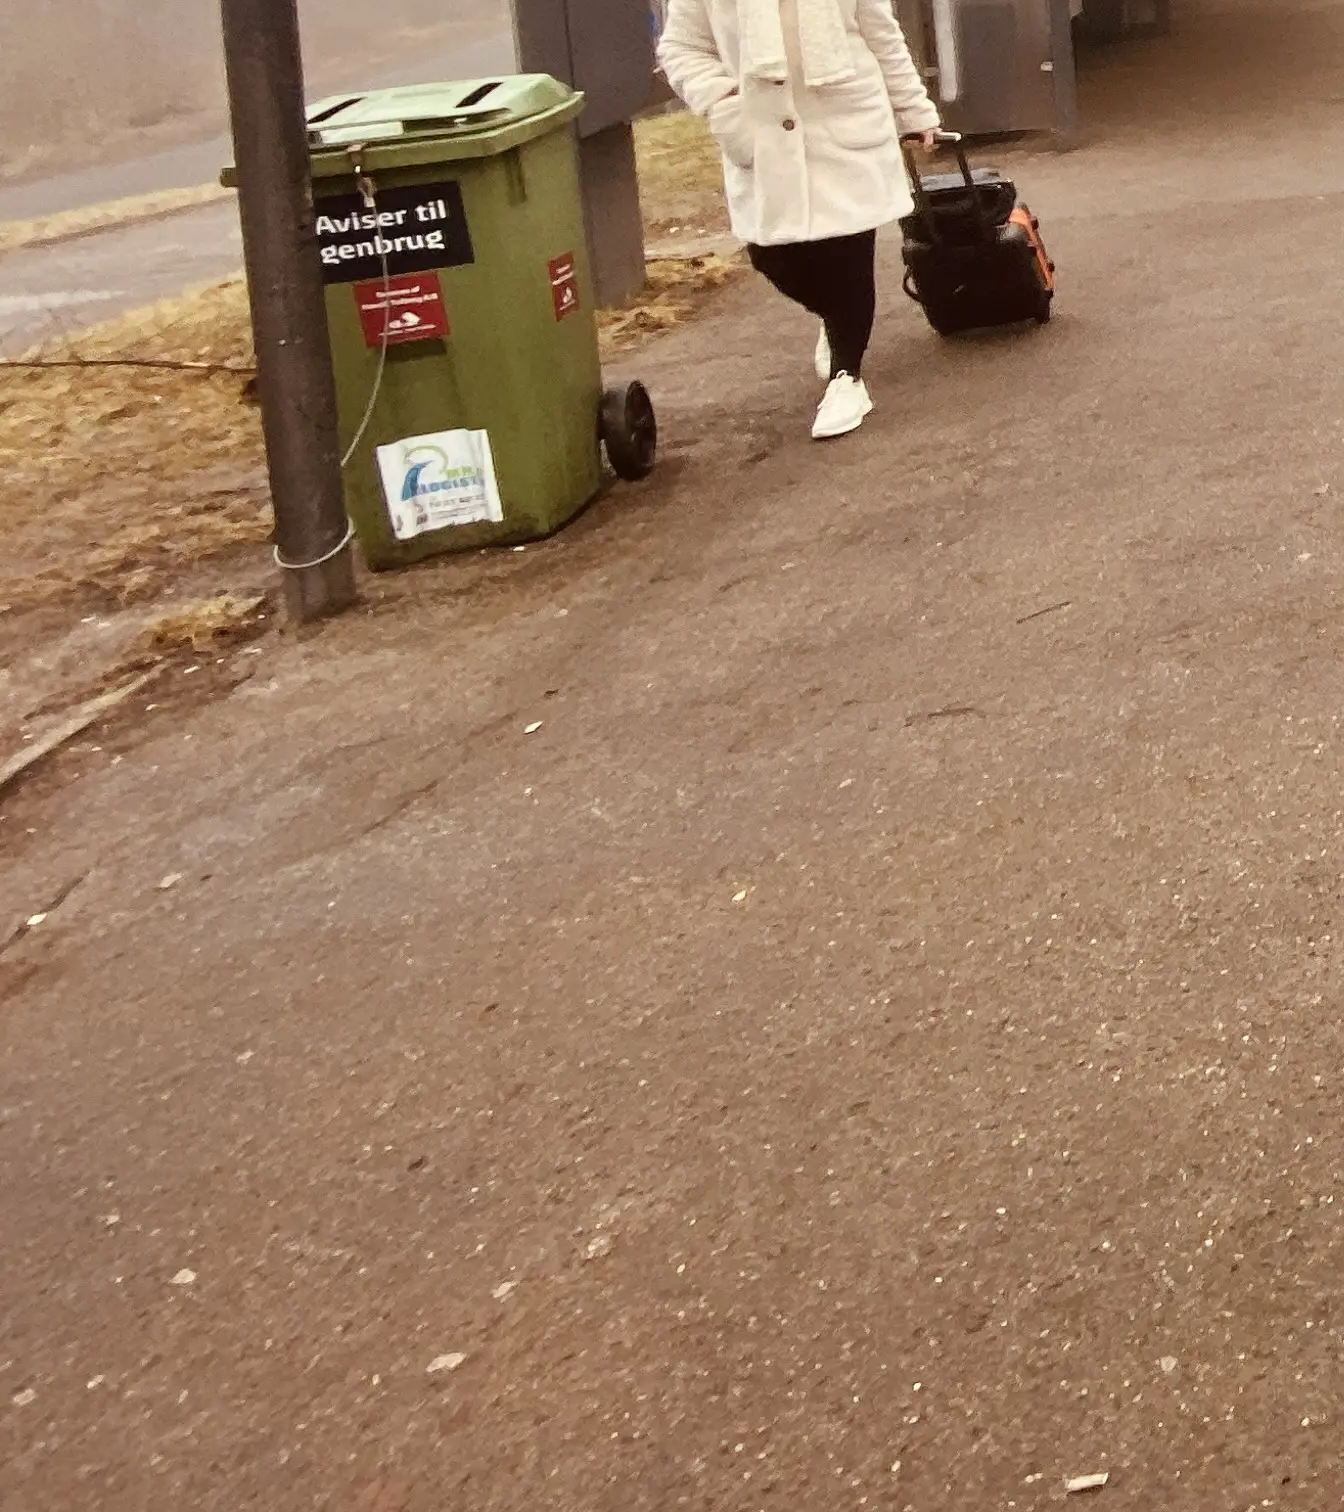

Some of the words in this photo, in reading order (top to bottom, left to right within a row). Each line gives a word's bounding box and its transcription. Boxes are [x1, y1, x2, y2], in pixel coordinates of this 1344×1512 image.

[315, 208, 408, 236] Aviser
[415, 199, 447, 222] til
[320, 229, 446, 265] genbrug
